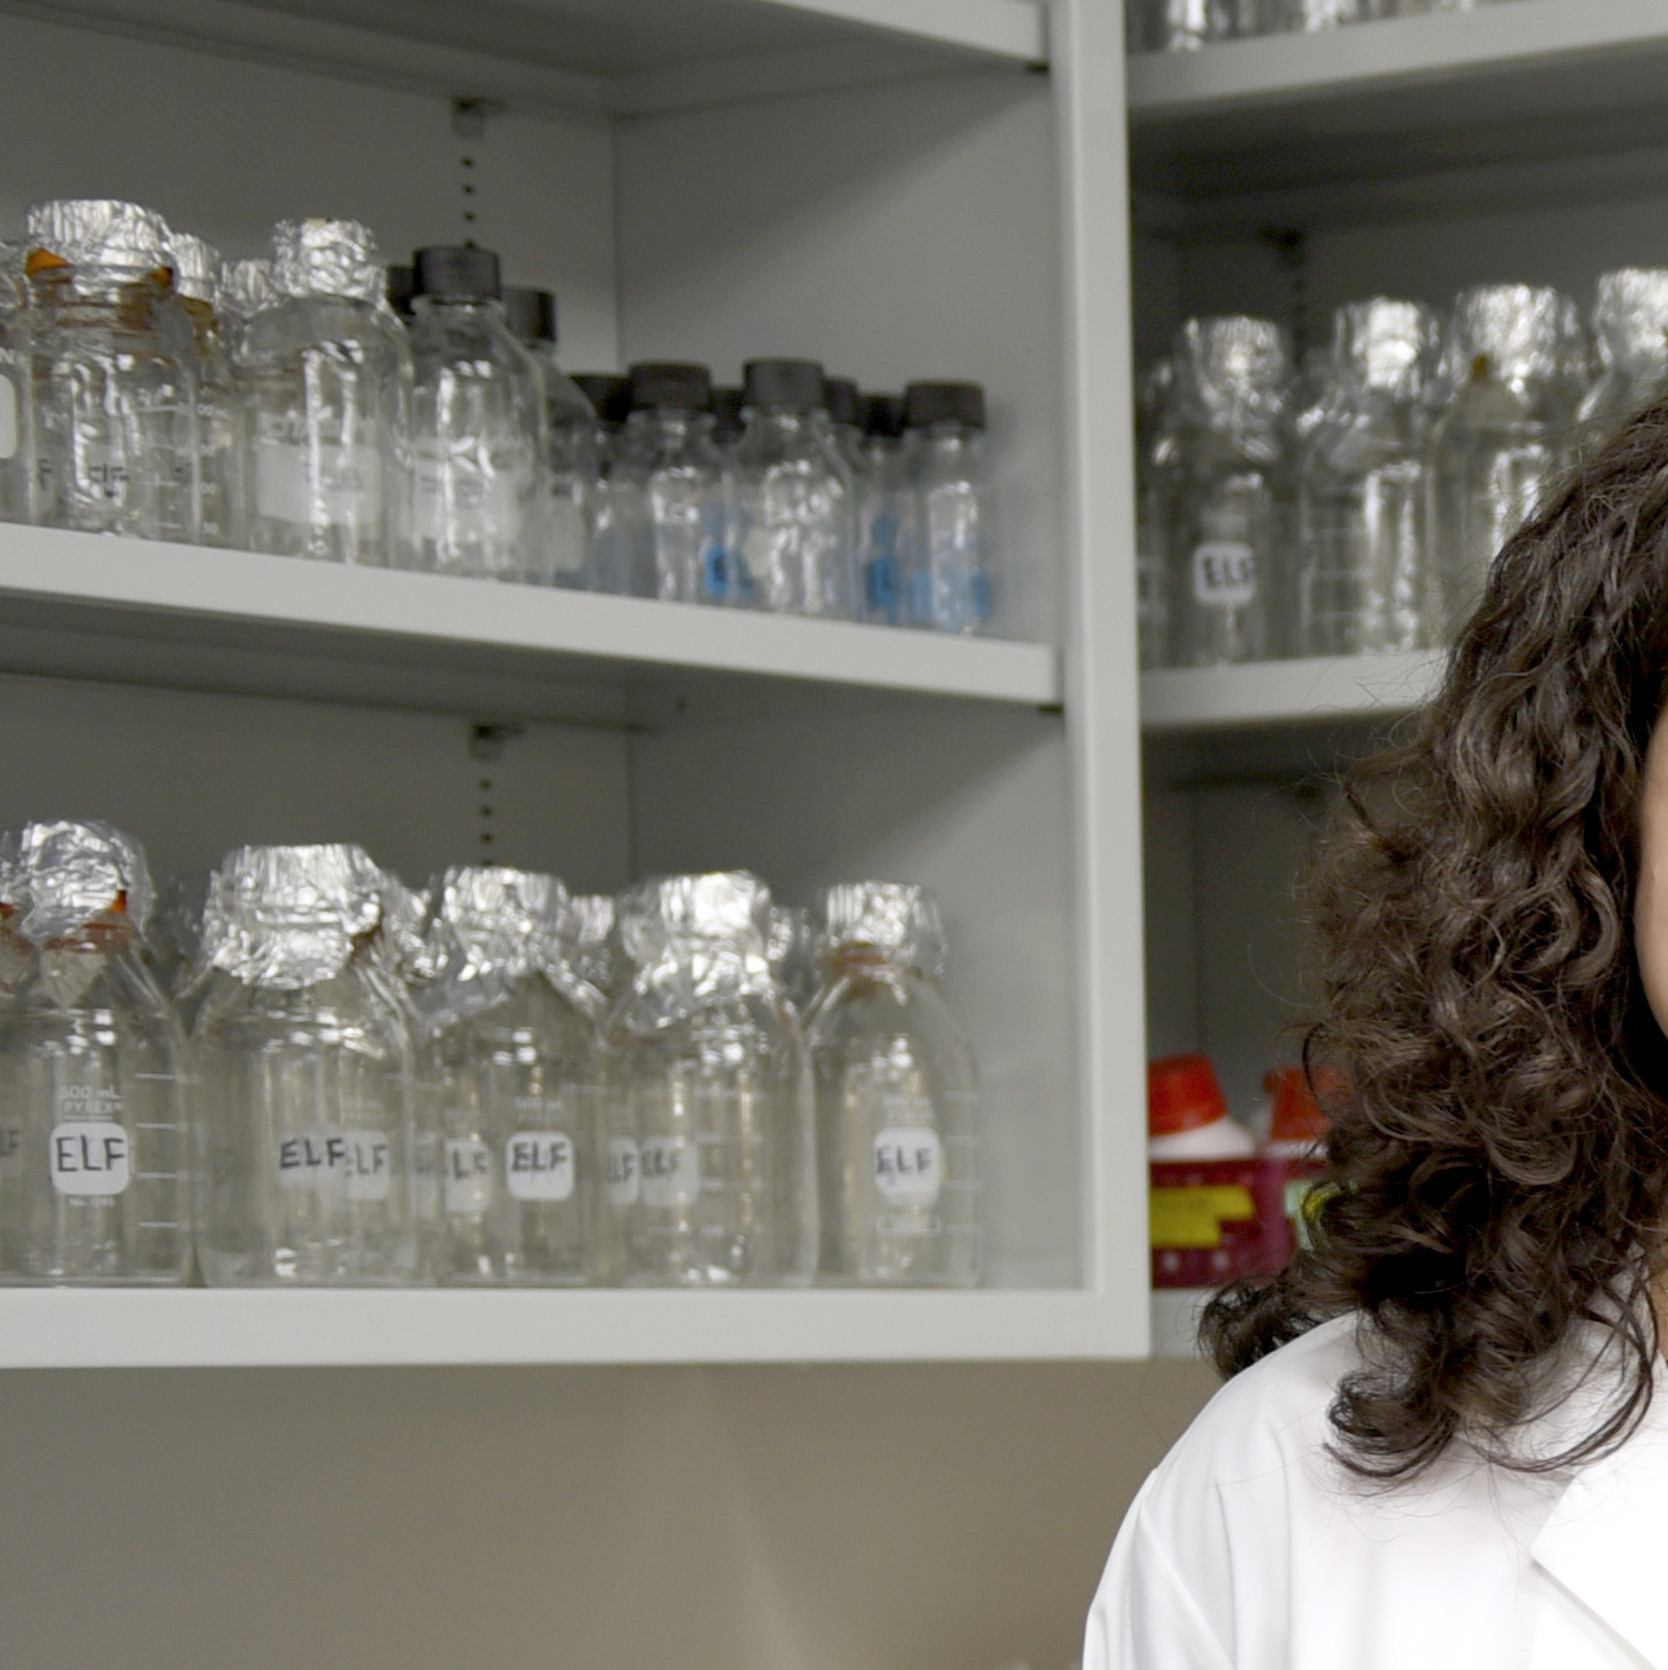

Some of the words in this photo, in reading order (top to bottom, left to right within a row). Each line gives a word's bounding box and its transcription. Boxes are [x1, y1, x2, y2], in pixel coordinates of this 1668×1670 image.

[55, 1134, 126, 1173] ELF
[278, 1137, 346, 1171] ELF
[510, 1141, 568, 1173] ELF
[874, 1146, 932, 1175] ELF
